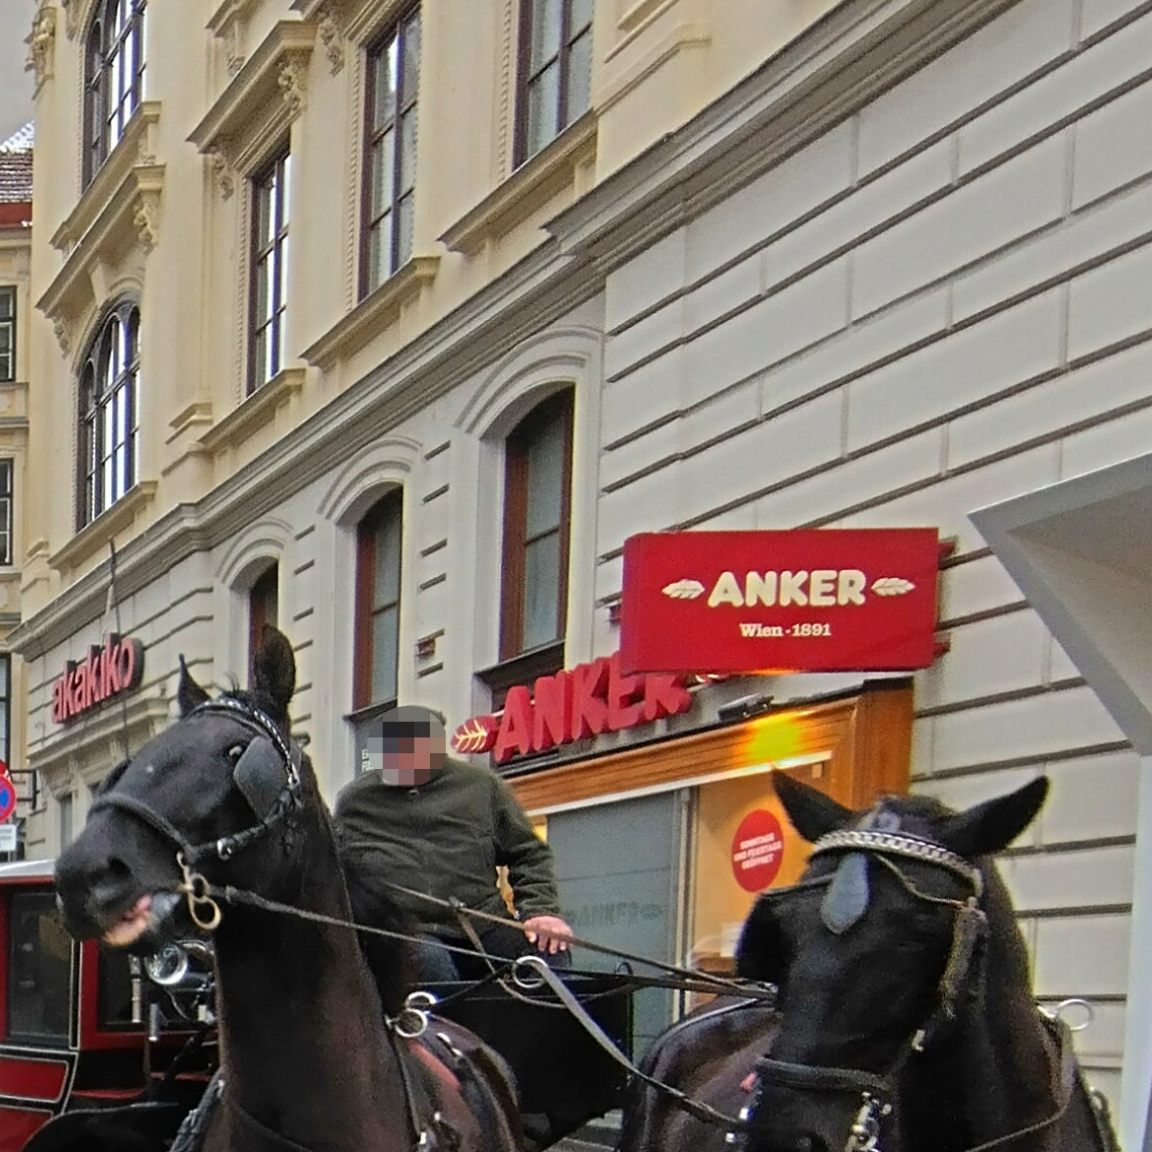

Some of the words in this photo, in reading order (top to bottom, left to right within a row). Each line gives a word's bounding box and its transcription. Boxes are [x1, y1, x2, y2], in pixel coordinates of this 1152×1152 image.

[707, 569, 867, 608] ANKER
[52, 632, 144, 725] akakiko
[494, 651, 691, 763] ANKER
